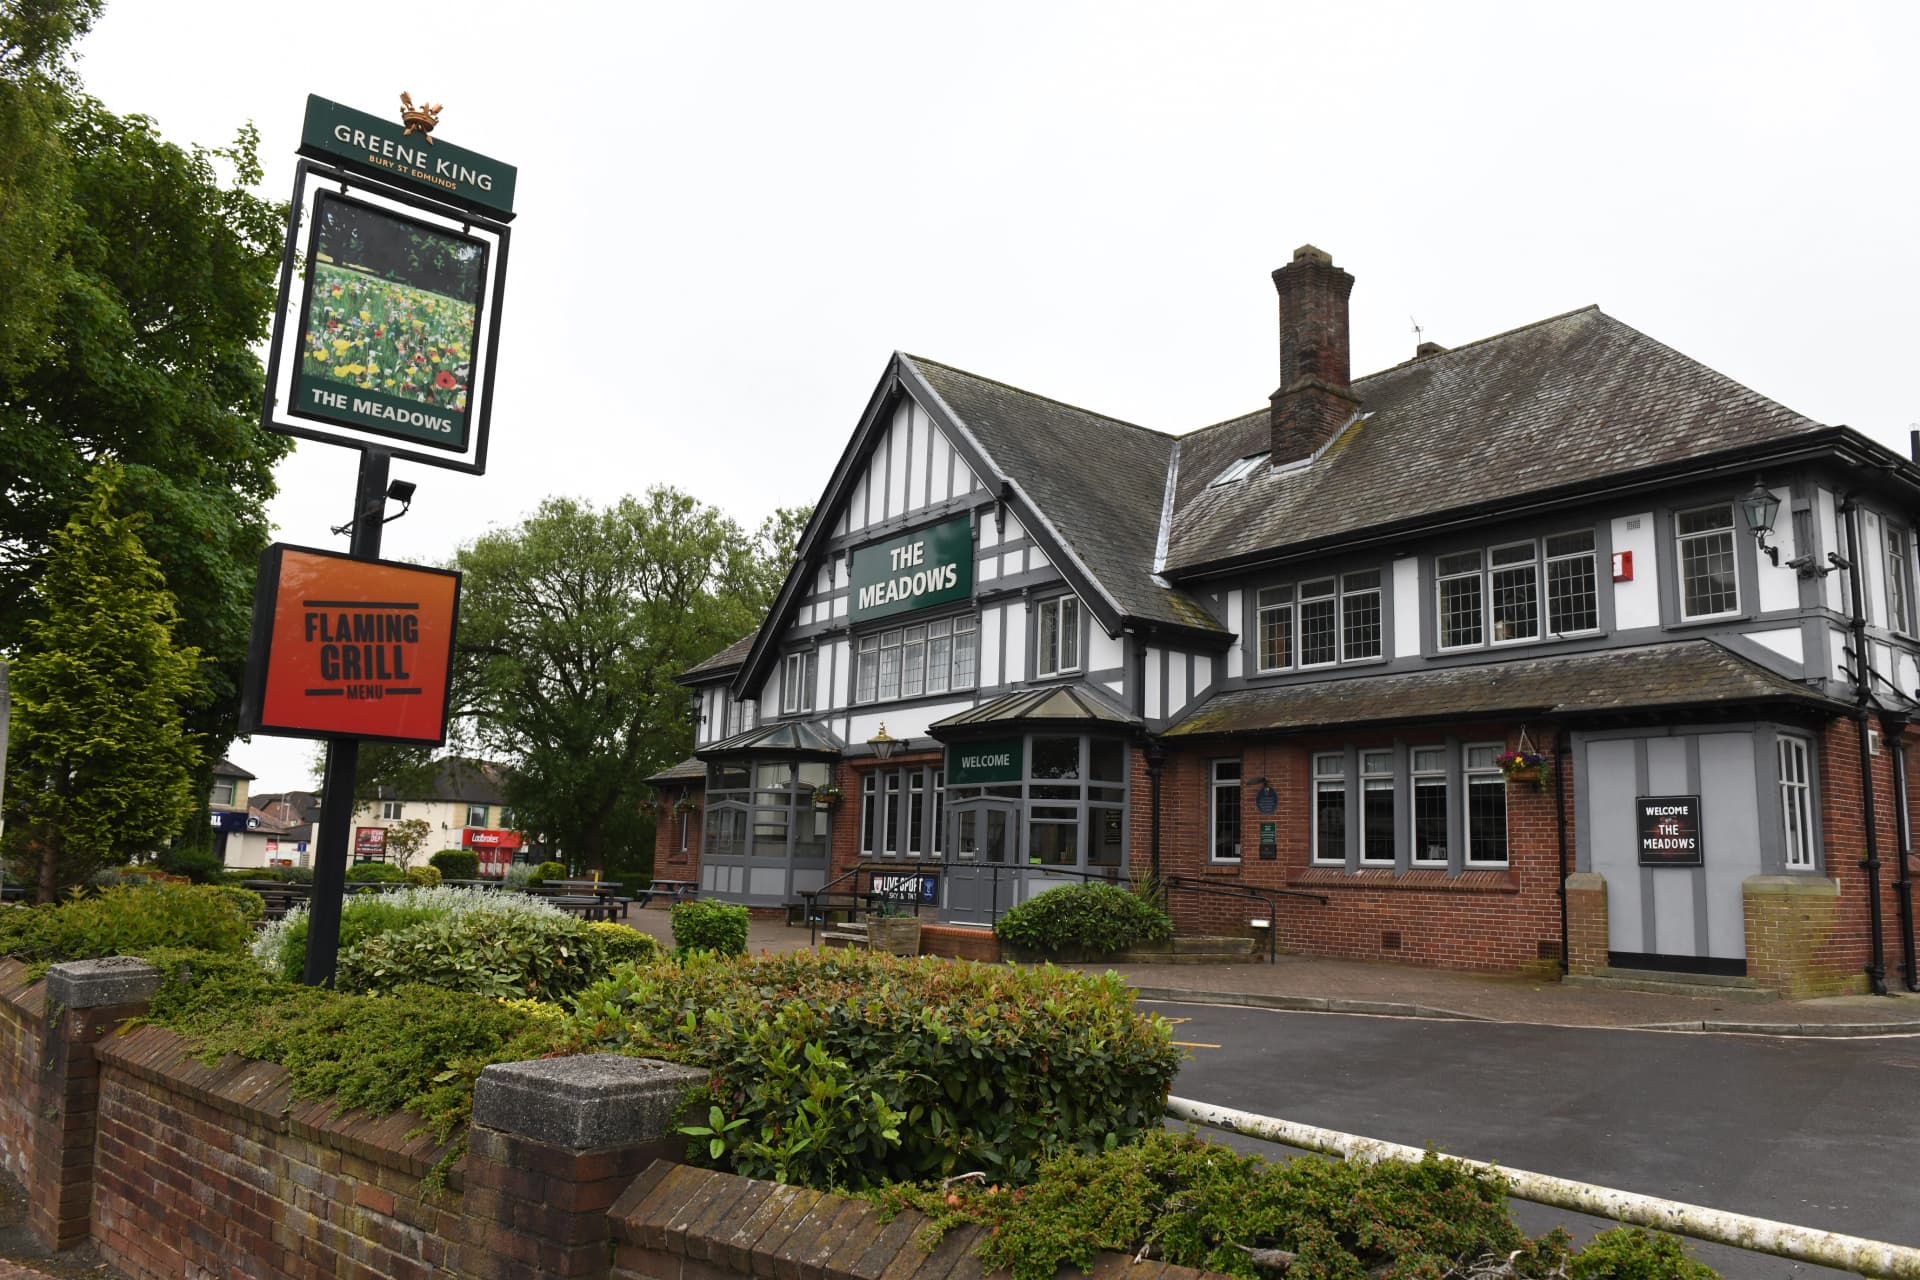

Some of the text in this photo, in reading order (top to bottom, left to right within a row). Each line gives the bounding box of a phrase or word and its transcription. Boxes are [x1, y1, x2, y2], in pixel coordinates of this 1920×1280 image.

[334, 124, 493, 191] GREENE KING
[369, 154, 457, 190] BURY ST EDMUNDS
[311, 388, 453, 433] THE MEADOWS
[859, 541, 957, 610] THE MEADOWS
[305, 612, 419, 643] FLAMING
[321, 644, 410, 681] GRILL
[346, 684, 383, 700] MENU
[961, 754, 1010, 768] WELCOME
[1645, 806, 1689, 816] WELCOME
[1658, 824, 1679, 836] THE
[1643, 838, 1695, 849] MEADOWS
[883, 876, 899, 892] LIVE
[888, 892, 899, 900] SKY
